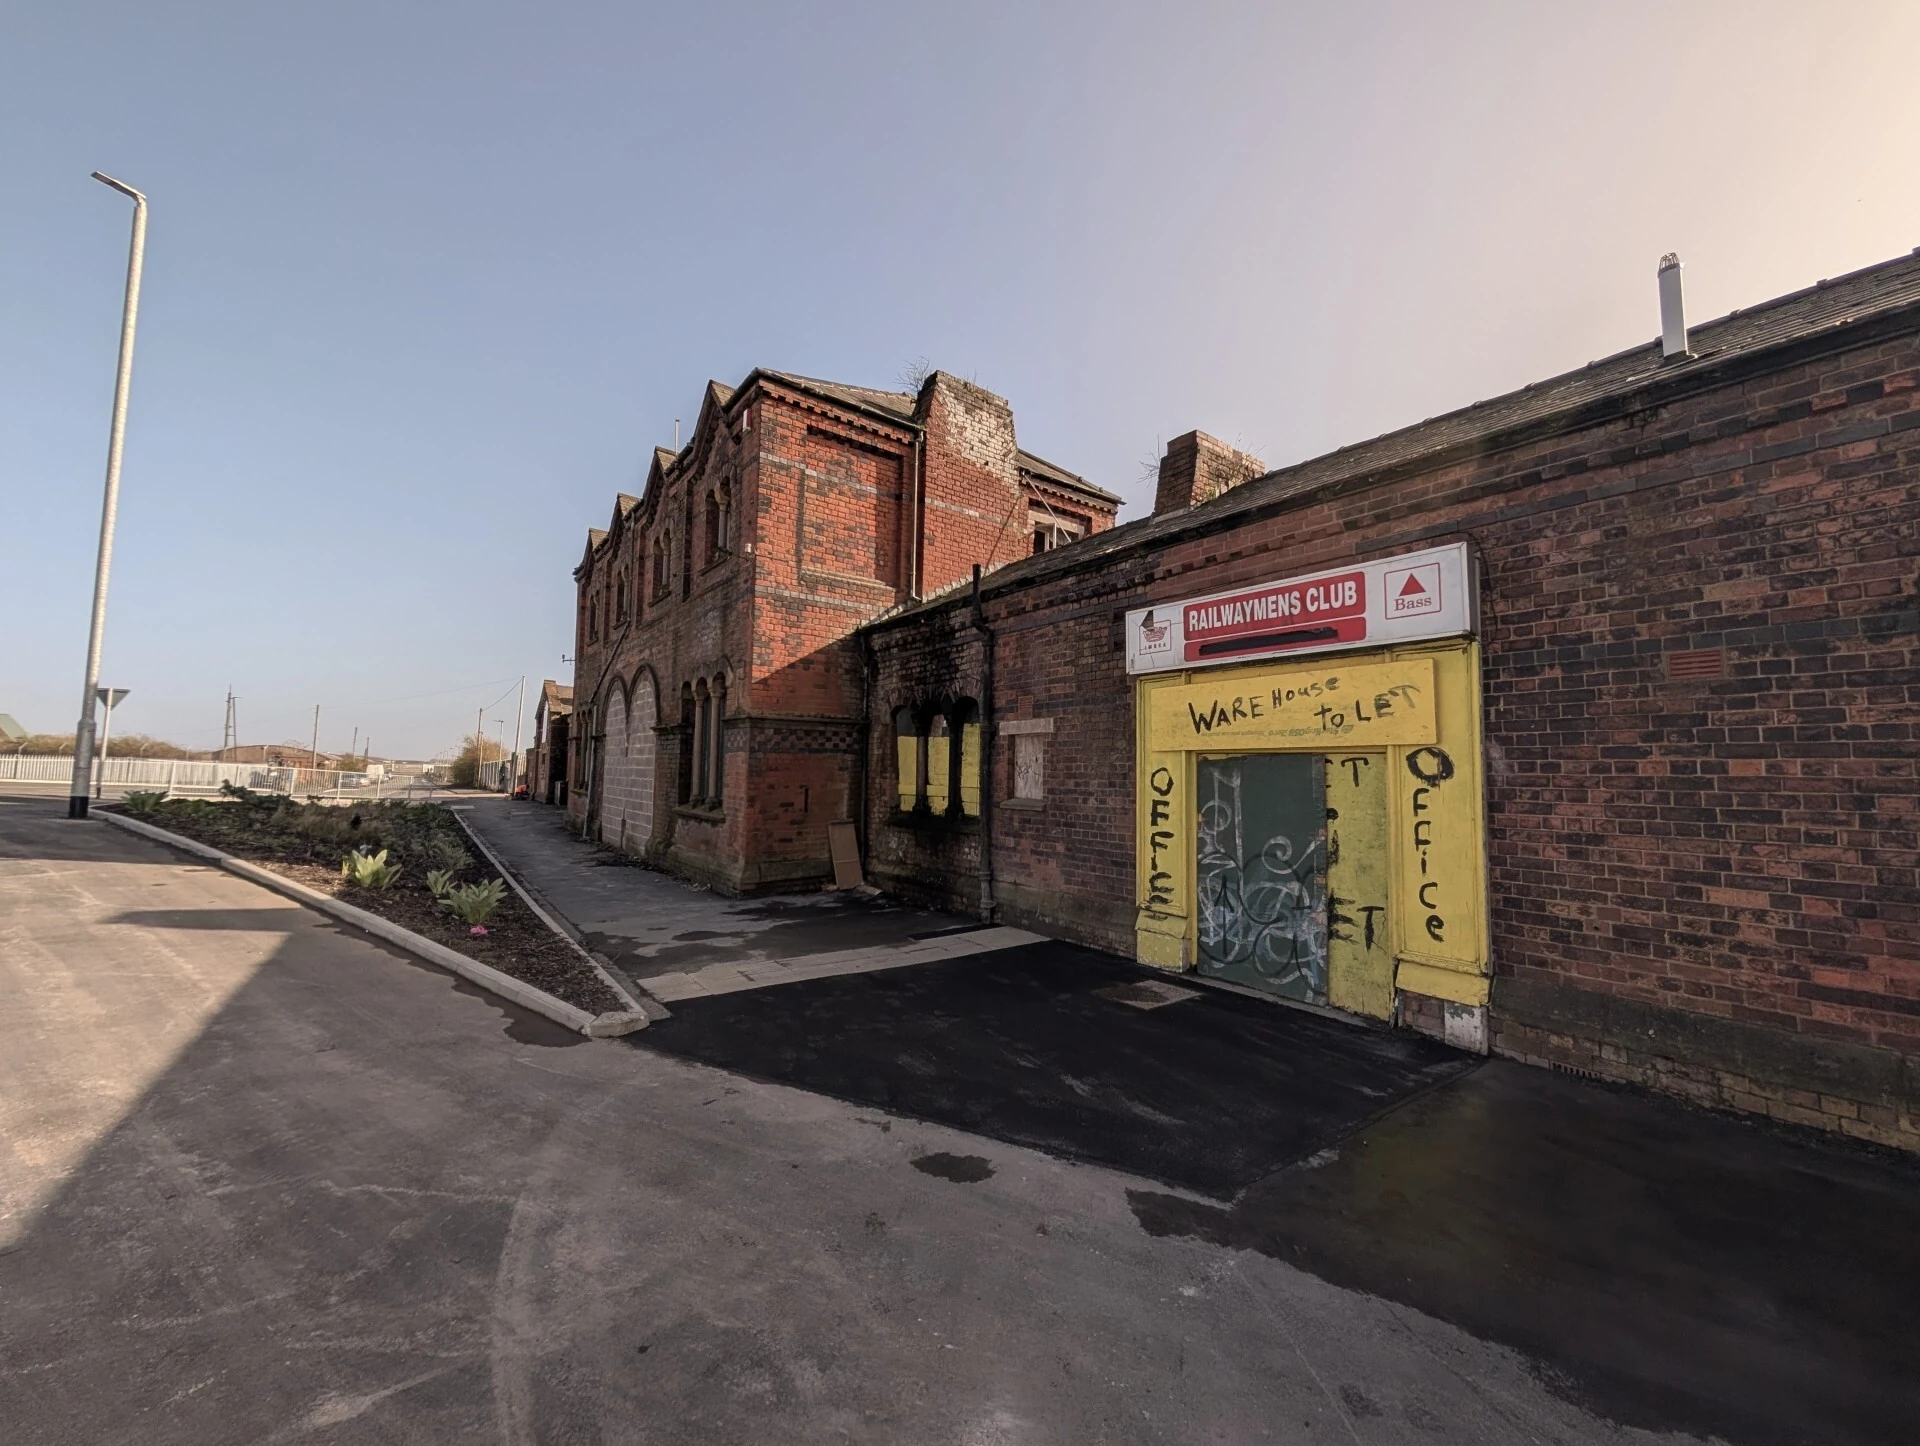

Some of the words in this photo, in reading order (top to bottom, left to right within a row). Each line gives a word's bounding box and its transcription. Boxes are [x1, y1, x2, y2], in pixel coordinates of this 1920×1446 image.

[1189, 590, 1302, 632] RAILWAYMENS
[1306, 581, 1358, 613] CLUB
[1393, 595, 1432, 612] Bass
[1355, 684, 1422, 723] LET
